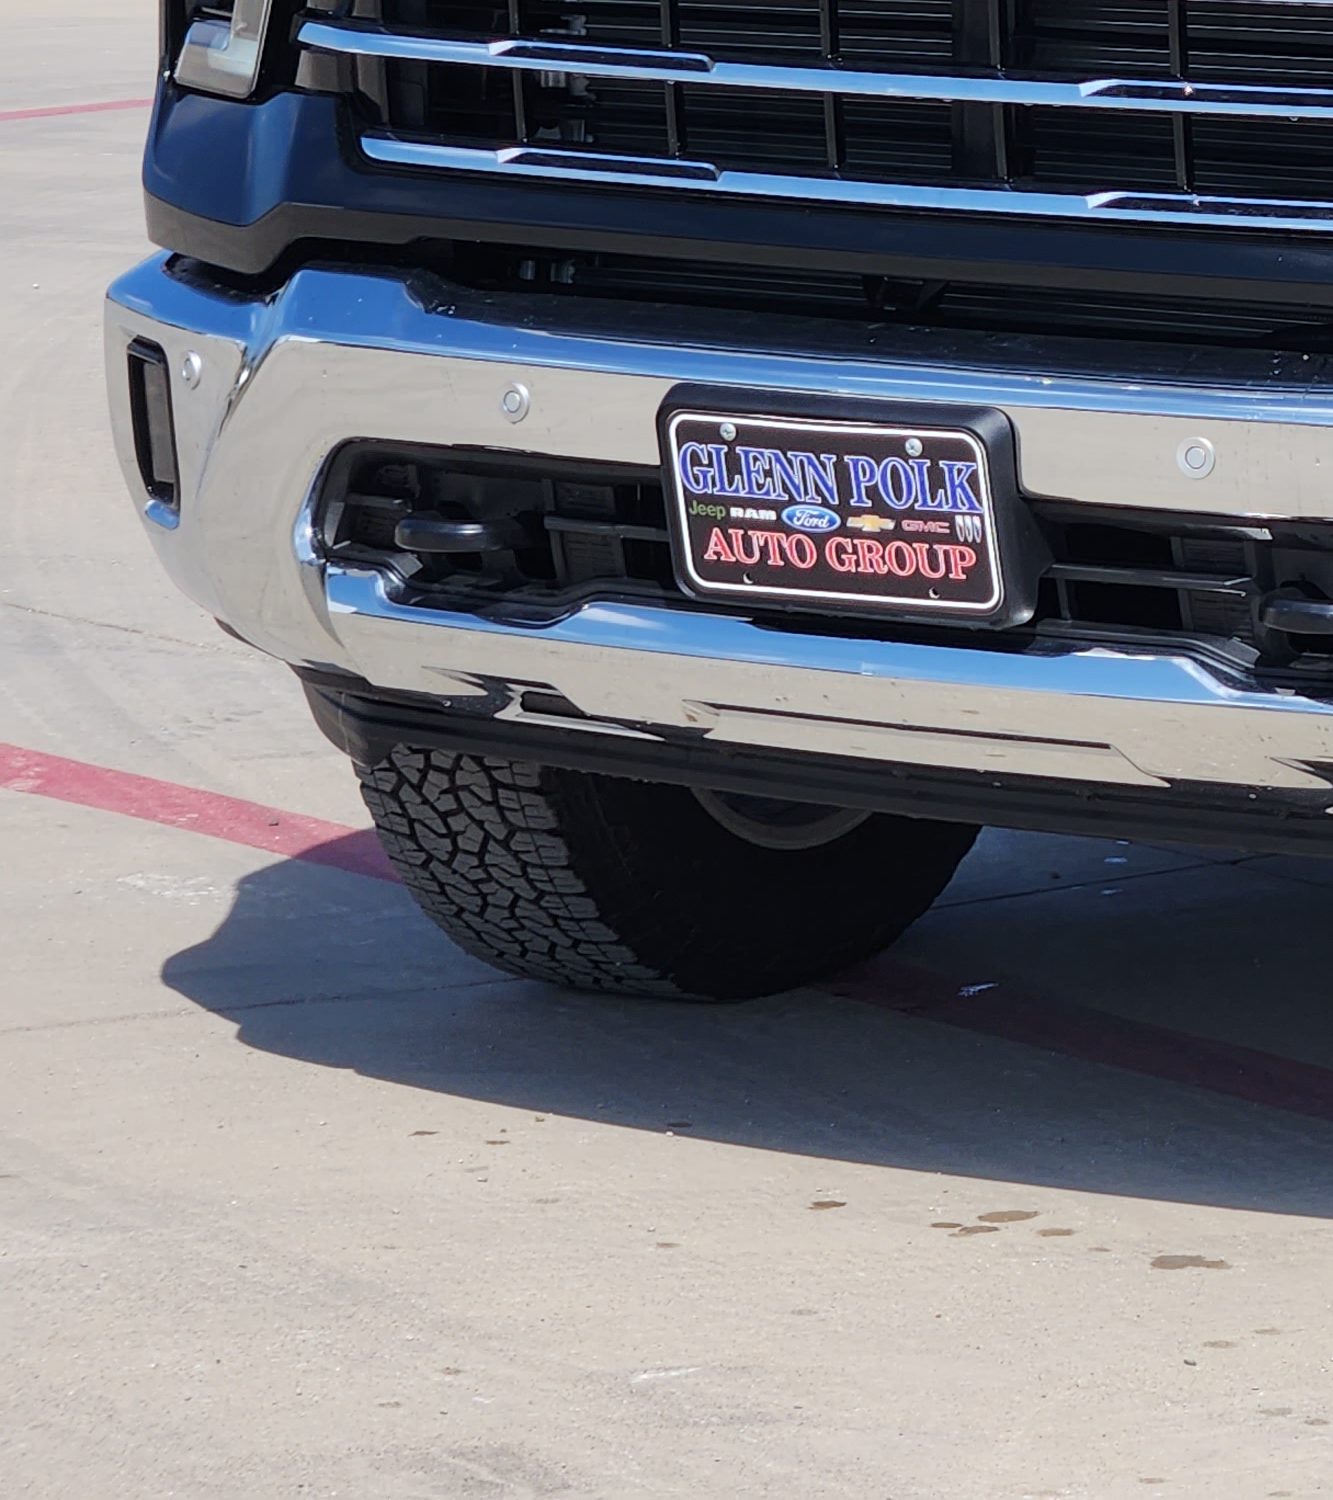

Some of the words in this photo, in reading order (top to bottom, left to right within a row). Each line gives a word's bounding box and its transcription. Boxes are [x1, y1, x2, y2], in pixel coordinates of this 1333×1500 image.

[678, 441, 839, 505] GLENN
[844, 455, 984, 513] POLK
[688, 499, 727, 521] Jeep
[729, 506, 777, 521] RAM
[789, 507, 832, 530] Ford
[901, 519, 951, 534] GMC
[703, 527, 817, 569] AUTO
[825, 536, 977, 580] GROUP
